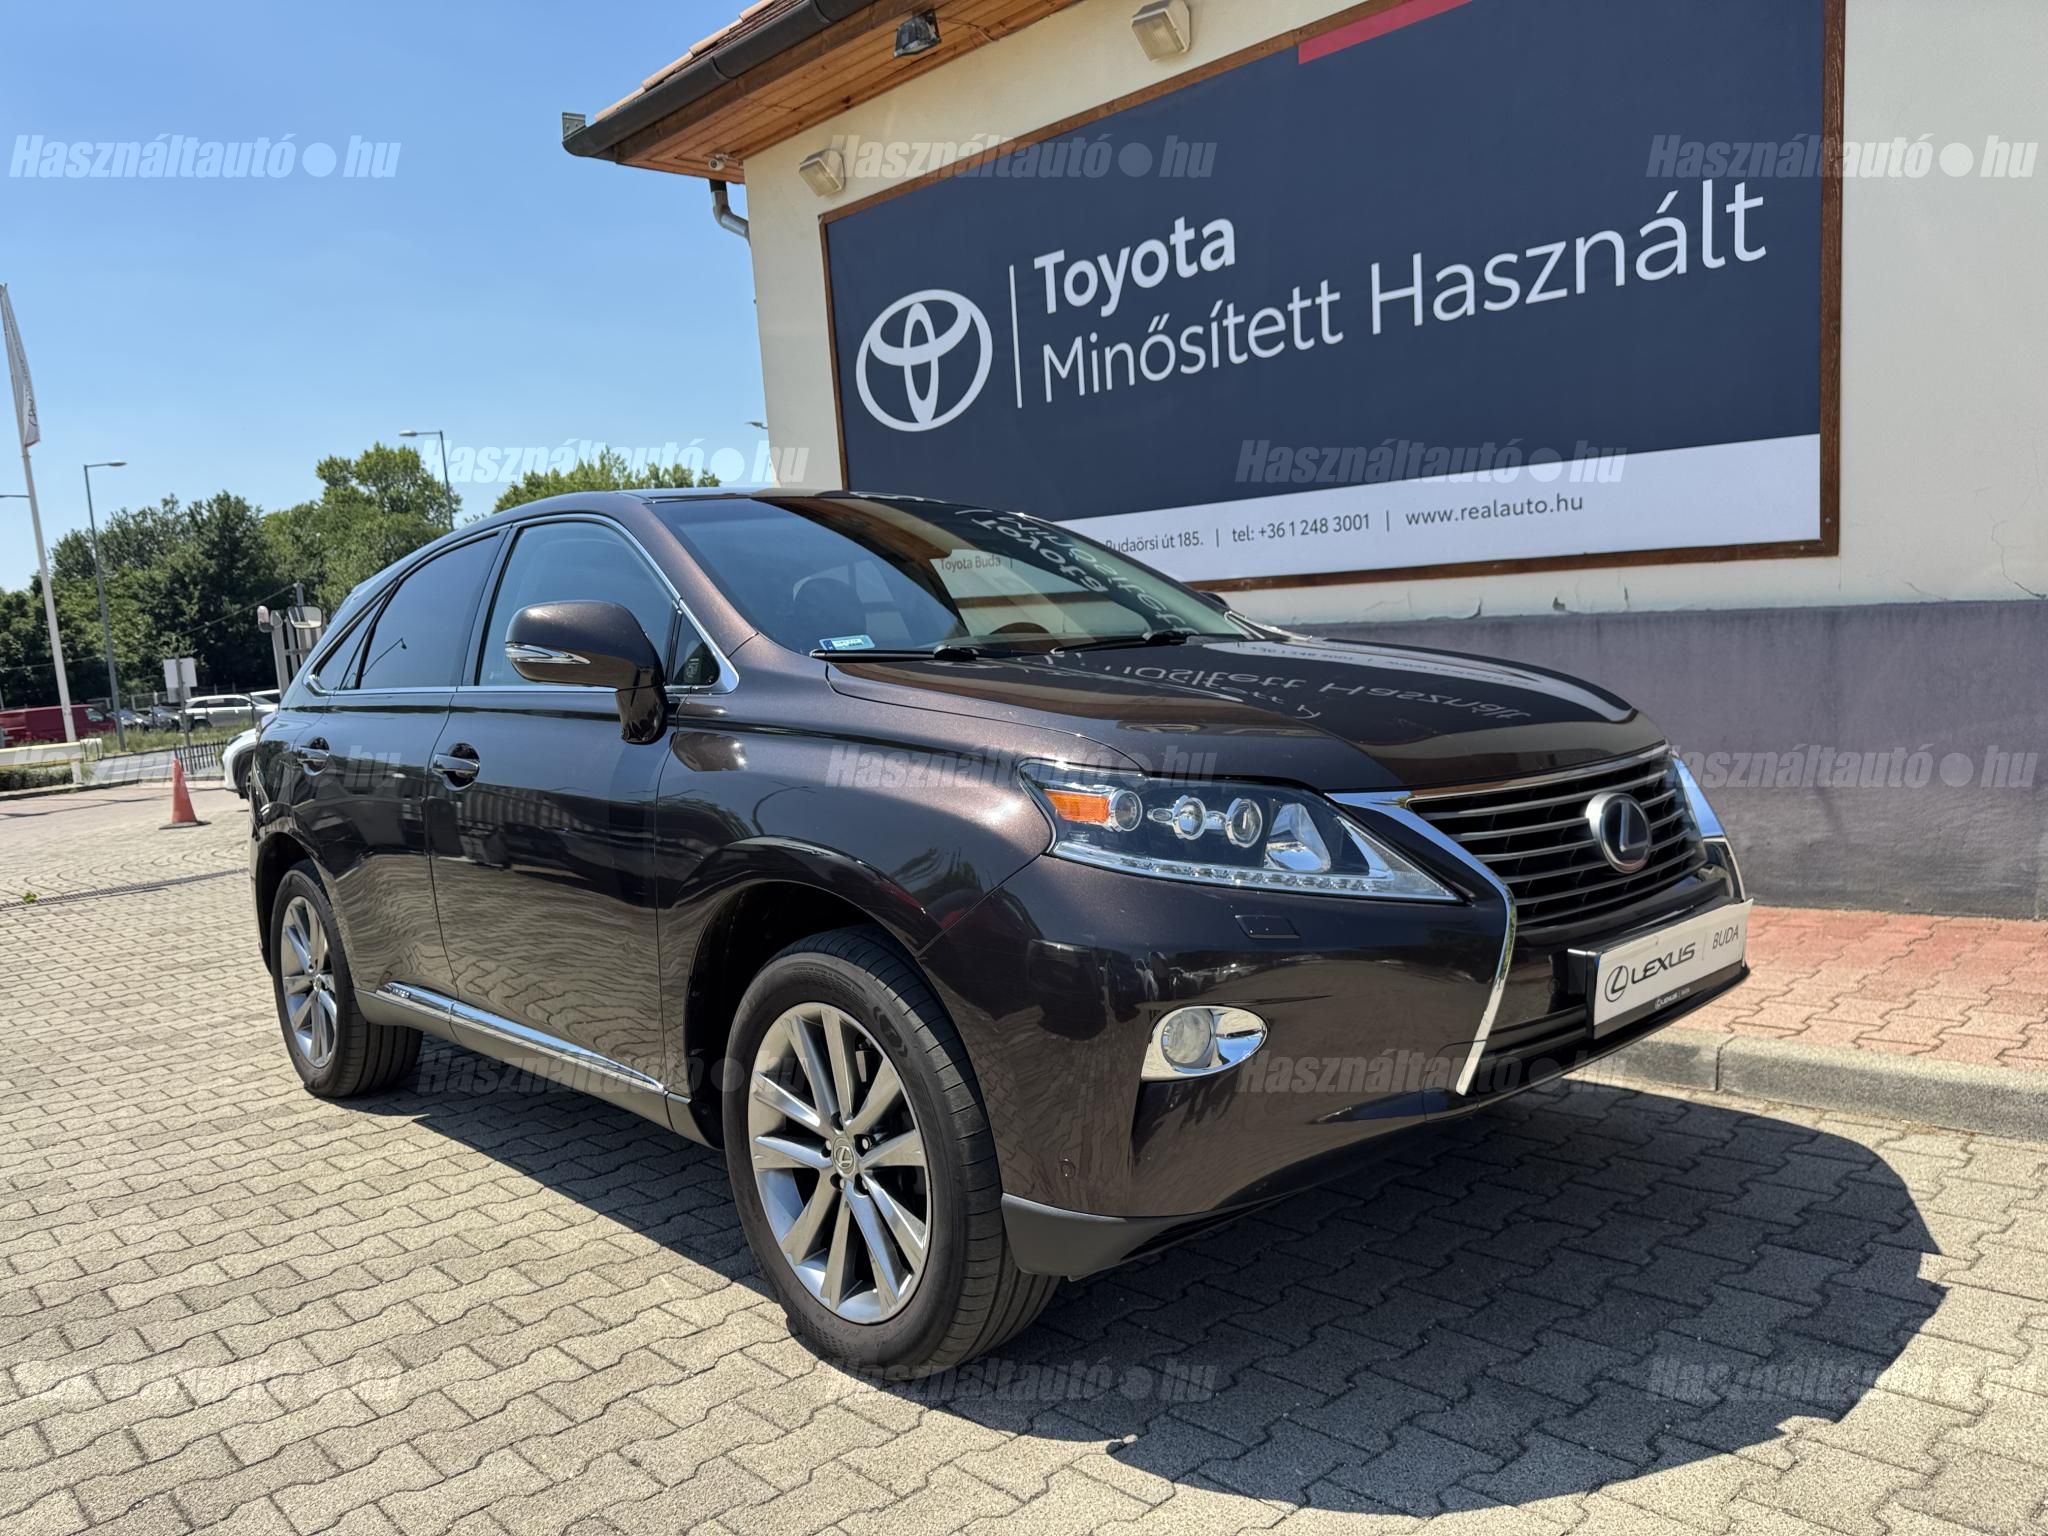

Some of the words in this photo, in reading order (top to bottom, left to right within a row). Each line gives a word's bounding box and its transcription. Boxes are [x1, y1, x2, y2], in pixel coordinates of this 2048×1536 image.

[1034, 216, 1235, 317] Toyota
[1043, 299, 1343, 403] Minősített
[1371, 179, 1767, 335] Használt
[940, 557, 973, 573] Toyota
[975, 554, 1001, 569] Buda
[1161, 533, 1175, 549] út
[1178, 530, 1203, 548] 185.
[1232, 526, 1255, 542] tel:
[1258, 522, 1285, 540] +36
[1299, 518, 1329, 537] 248
[1333, 513, 1371, 533] 3001
[1405, 493, 1584, 527] www.realauto.hu
[1631, 942, 1696, 985] LEXUS
[1712, 924, 1739, 950] BUDA
